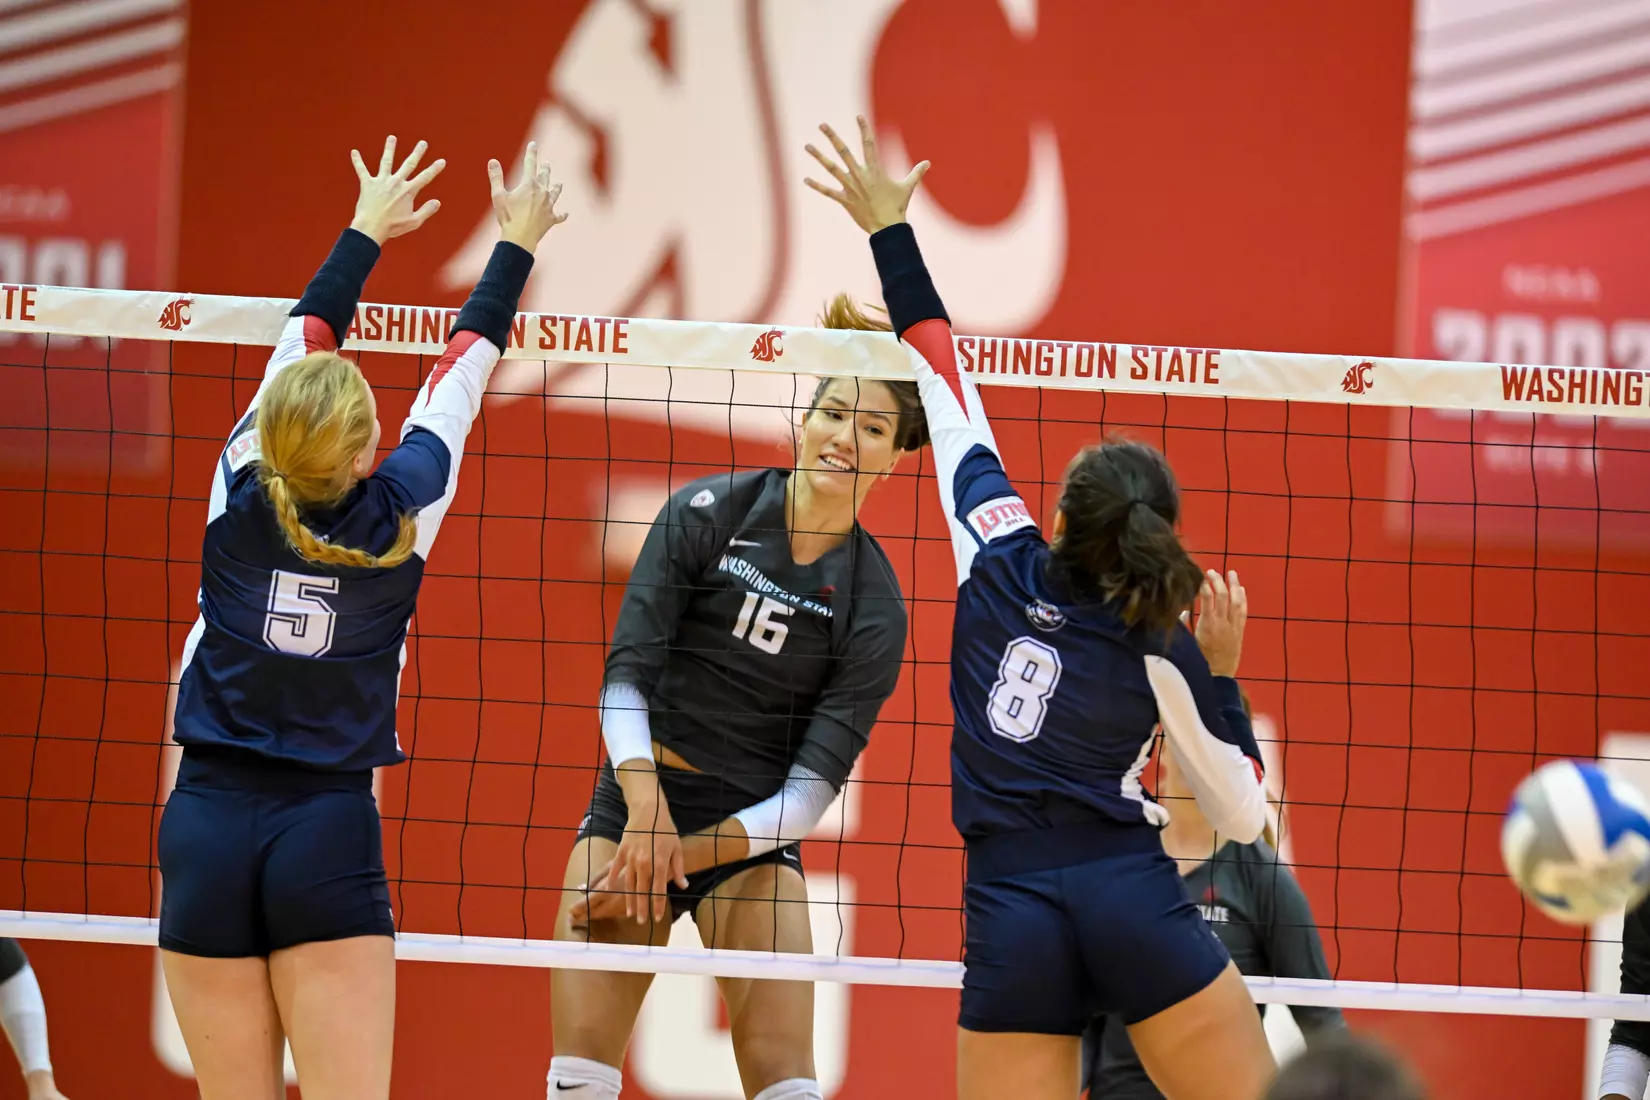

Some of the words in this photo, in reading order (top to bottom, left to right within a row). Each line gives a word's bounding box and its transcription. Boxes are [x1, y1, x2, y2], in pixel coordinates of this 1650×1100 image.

[0, 285, 37, 321] TE
[538, 315, 630, 354] STATE
[957, 337, 1117, 379] SHINGTON
[1130, 346, 1221, 385] STATE
[1500, 365, 1650, 407] WASHING
[976, 502, 1029, 538] ALLEY
[718, 553, 801, 603] WASHINGTON
[263, 569, 339, 658] 5
[731, 591, 796, 655] 16
[986, 635, 1063, 743] 8
[1195, 904, 1230, 925] TATE
